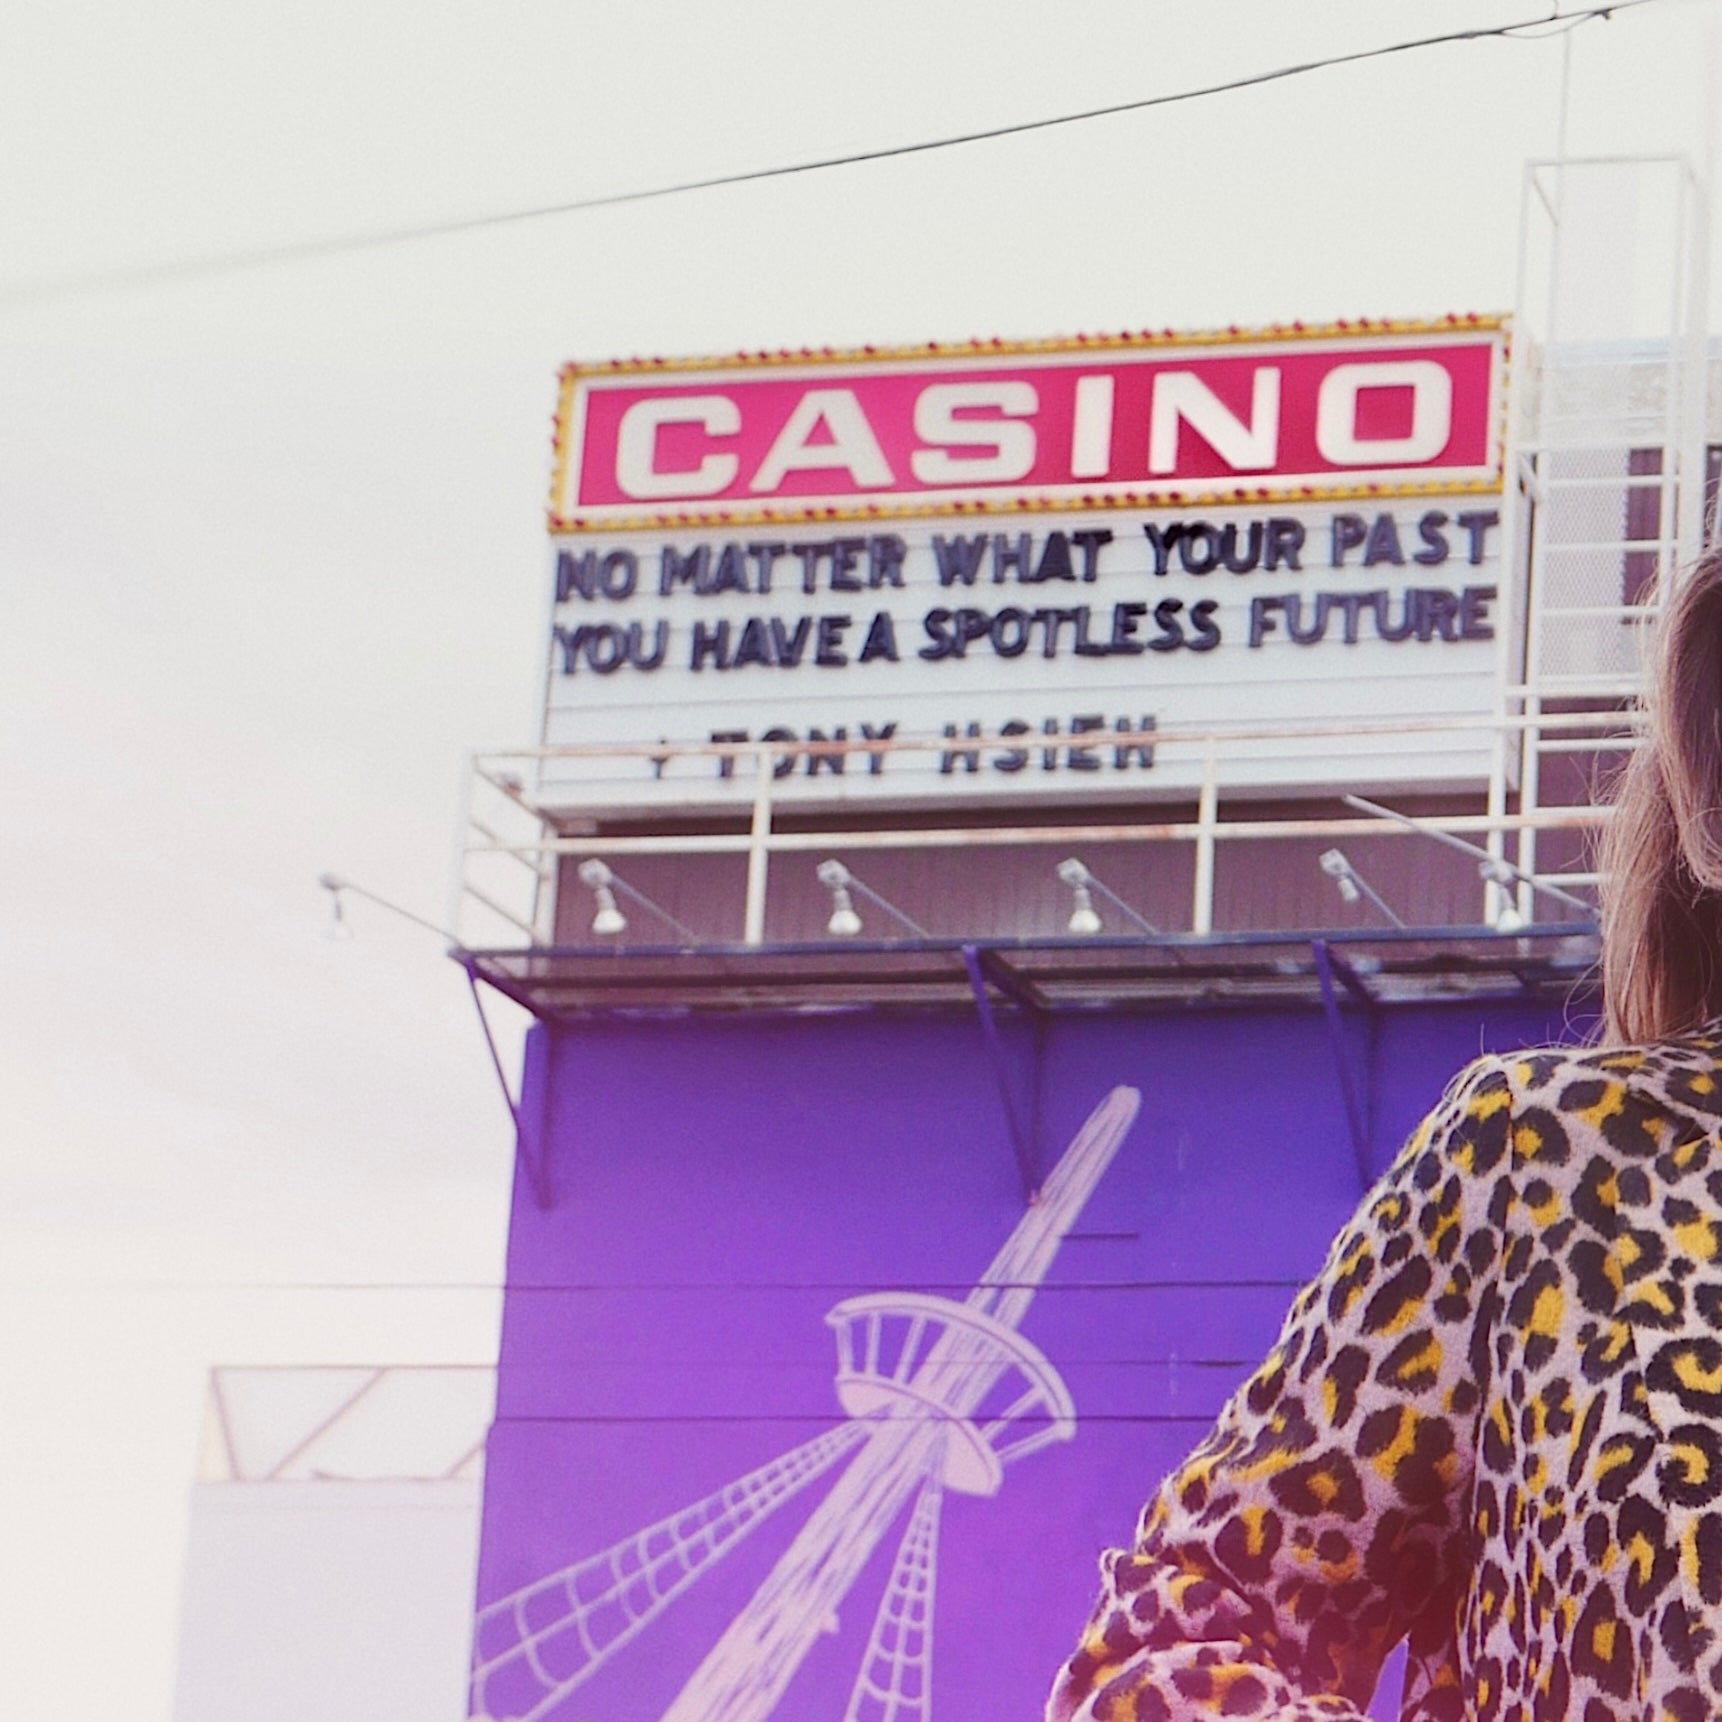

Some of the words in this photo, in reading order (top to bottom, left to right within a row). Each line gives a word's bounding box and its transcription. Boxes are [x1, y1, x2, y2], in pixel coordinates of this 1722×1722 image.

[616, 360, 1453, 500] CASINO
[555, 548, 638, 602] NO
[659, 533, 907, 597] MATTER
[932, 529, 1113, 586] WHAT
[1144, 517, 1306, 576] YOUR
[1331, 511, 1499, 568] PAST
[553, 619, 669, 675] YOU
[690, 615, 852, 672] HAVE
[858, 611, 900, 663] A
[918, 597, 1222, 661] SPOTLESS
[1249, 584, 1498, 648] FUTURE
[939, 713, 1156, 774] HSIEH
